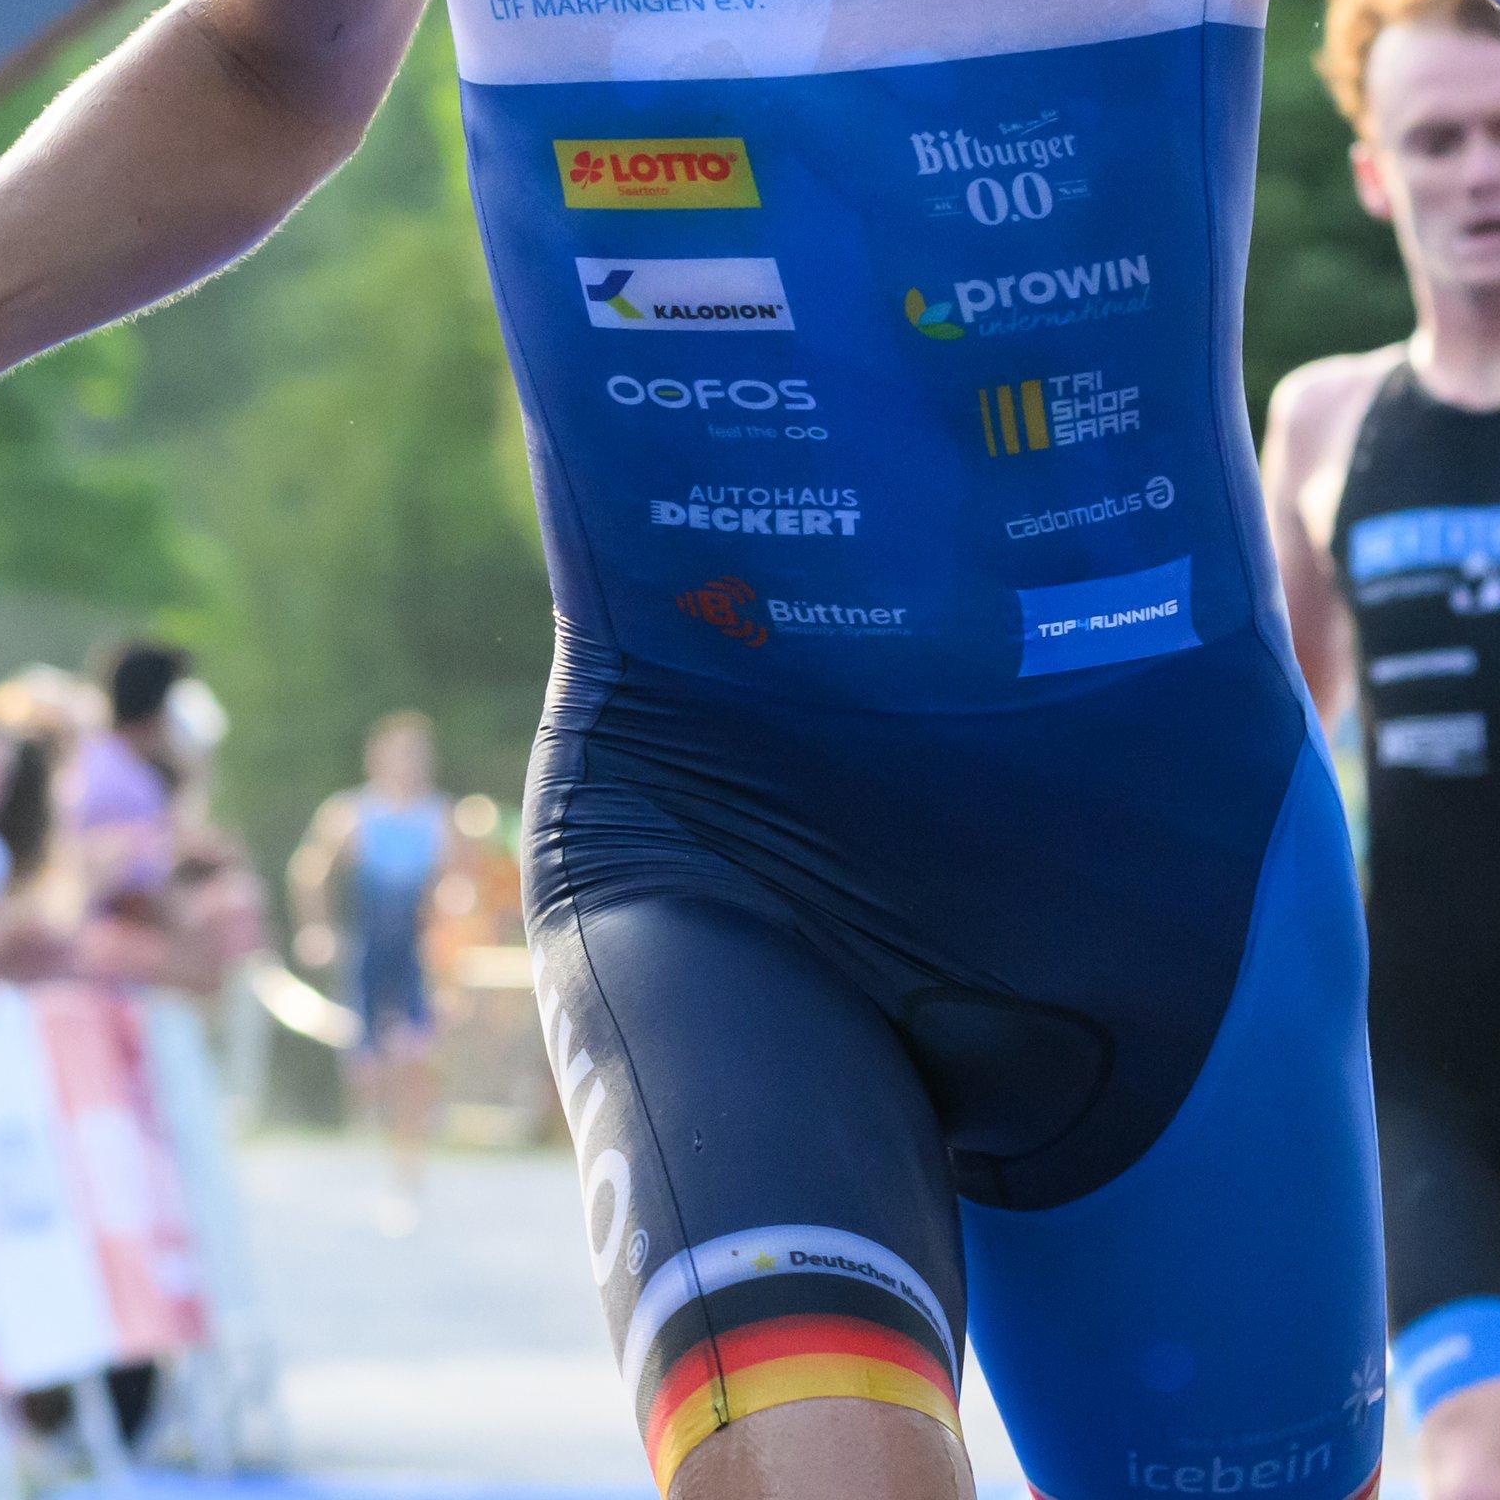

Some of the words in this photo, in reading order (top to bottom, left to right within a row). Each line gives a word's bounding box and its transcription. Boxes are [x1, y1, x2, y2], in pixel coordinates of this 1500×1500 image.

[610, 152, 731, 183] LOTTO
[910, 129, 1077, 175] Bitburger
[966, 171, 1053, 226] 0.0
[606, 375, 817, 410] OOFOS
[1049, 370, 1103, 397] TRI
[1051, 386, 1140, 422] SHOP
[1053, 409, 1141, 446] SAAR
[689, 485, 860, 507] AUTOHAUS
[650, 500, 861, 536] DECKERT
[767, 599, 908, 626] Büttner
[1037, 599, 1179, 638] TOP4RUNNING
[789, 1250, 897, 1289] Deutscher
[1127, 1443, 1332, 1493] icebein
